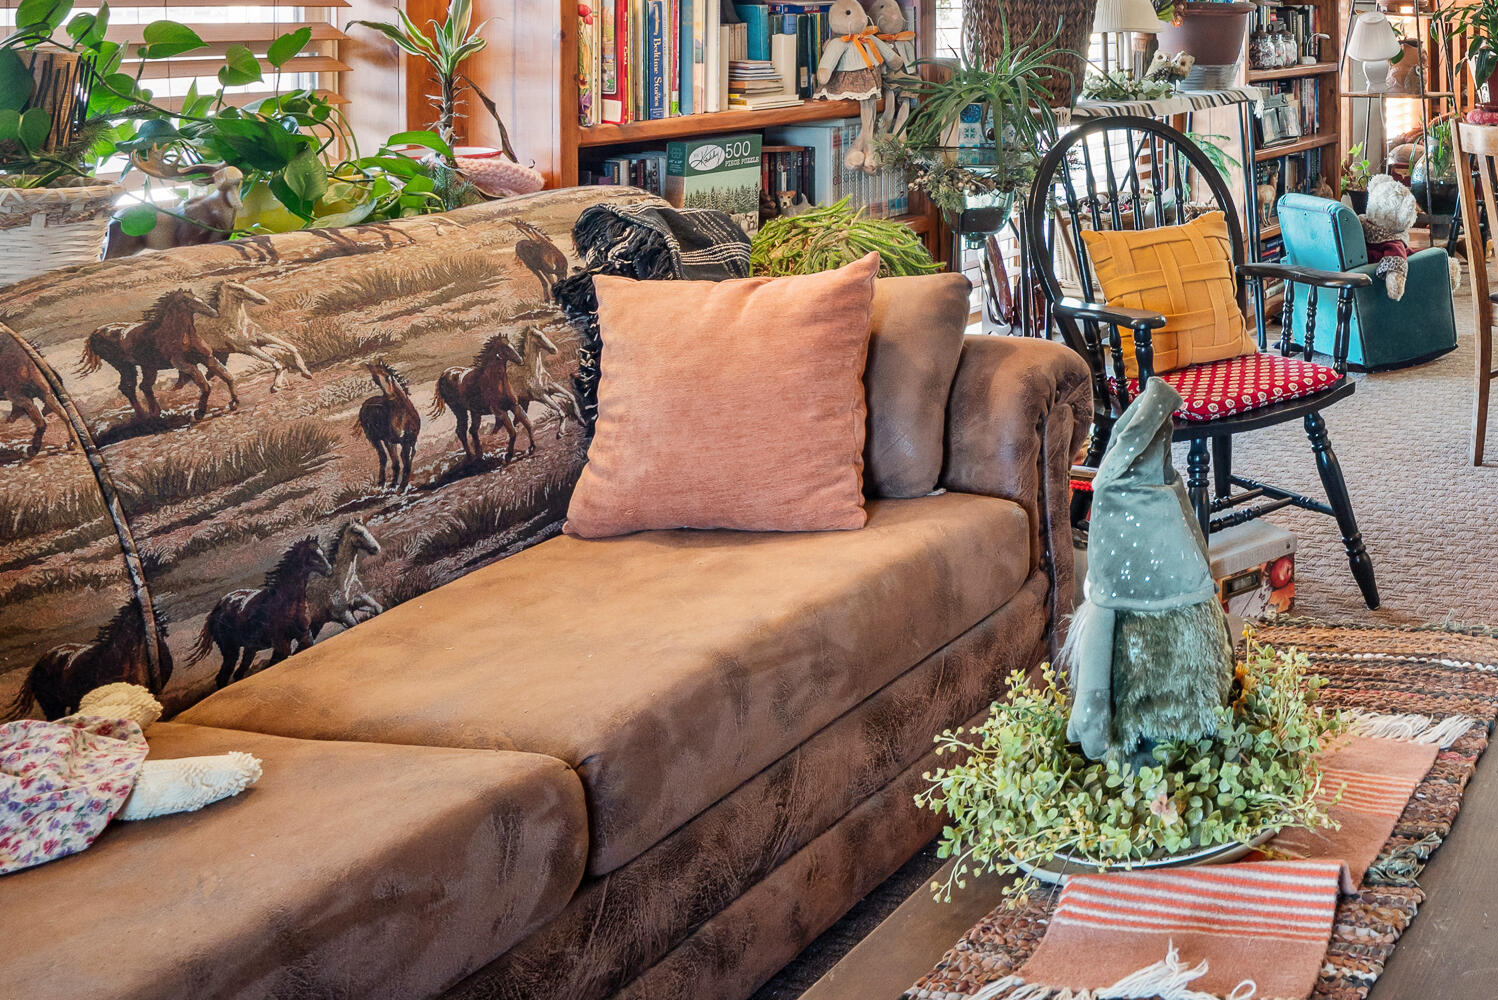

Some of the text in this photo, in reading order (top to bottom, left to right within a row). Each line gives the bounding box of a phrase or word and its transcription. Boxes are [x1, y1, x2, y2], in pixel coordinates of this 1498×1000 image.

[652, 38, 661, 74] Bedtime
[653, 76, 662, 107] Stories
[725, 140, 751, 159] 500
[725, 156, 760, 167] PIECE PUZZLE
